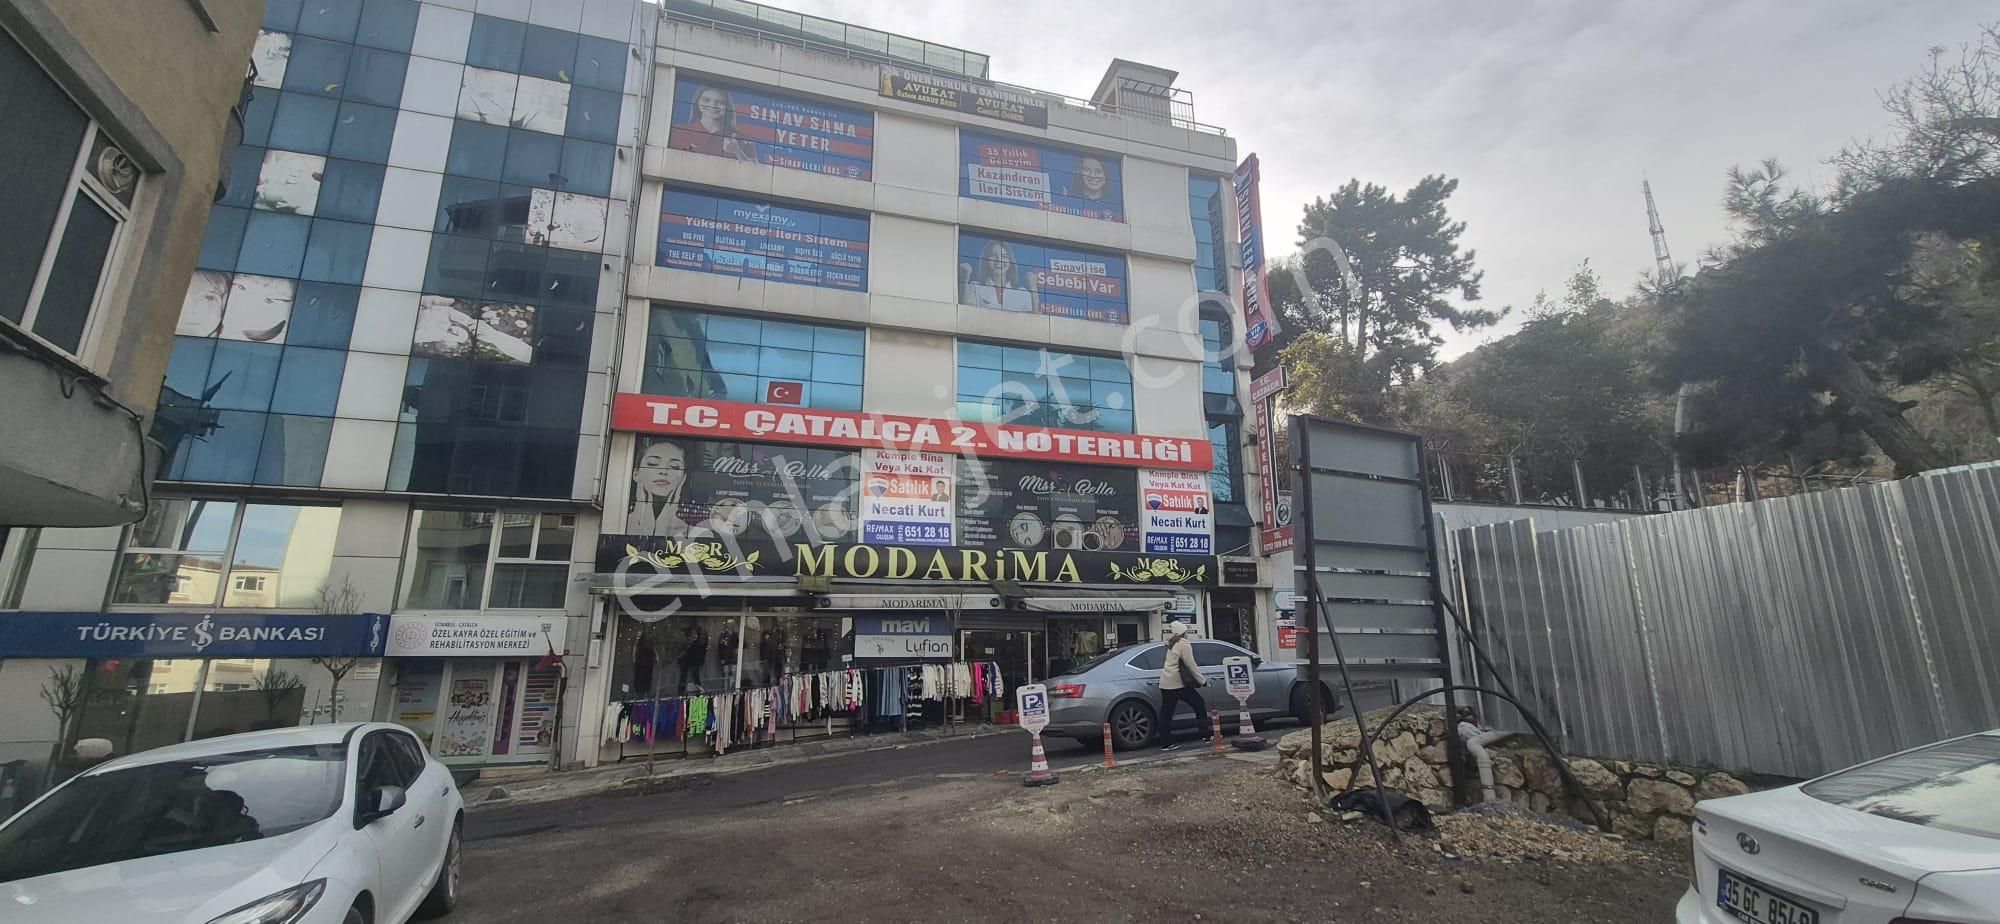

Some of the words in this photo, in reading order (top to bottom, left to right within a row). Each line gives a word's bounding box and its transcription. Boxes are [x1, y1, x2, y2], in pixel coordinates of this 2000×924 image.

[904, 82, 955, 100] AVUKAT
[976, 97, 1024, 113] AVUKAT
[750, 105, 803, 126] SINAV
[810, 116, 857, 137] SANA
[776, 128, 830, 152] YETER
[977, 167, 1041, 185] Kazandıran
[1005, 186, 1045, 201] Sistem
[685, 216, 731, 232] Yüksek
[806, 234, 848, 248] Sistem
[1089, 264, 1105, 274] ise
[1037, 272, 1087, 291] Sebebi
[1088, 278, 1115, 294] Var
[1245, 274, 1260, 315] KURS
[1250, 326, 1261, 338] VIP
[646, 401, 731, 429] T.C.
[743, 409, 941, 446] ÇATALCA
[951, 426, 987, 448] 2.
[998, 429, 1193, 463] NOTERLİĞİ
[876, 450, 917, 462] Komple
[920, 453, 944, 463] Bina
[874, 462, 901, 472] Veya
[904, 464, 923, 473] Kat
[926, 465, 945, 474] Kat
[1149, 470, 1179, 480] Komple
[1180, 472, 1199, 480] Bina
[890, 478, 929, 495] Satılık
[1019, 475, 1057, 494] Miss
[1074, 479, 1117, 496] Bella
[1149, 480, 1169, 489] Veya
[1171, 481, 1185, 489] Kat
[1187, 482, 1201, 490] Kat
[1162, 494, 1193, 509] Satılık
[872, 503, 914, 517] Necati
[918, 504, 946, 518] Kurt
[866, 524, 894, 534] RE/MAX
[1151, 515, 1182, 528] Necati
[1185, 517, 1206, 528] Kurt
[904, 525, 921, 538] 651
[924, 526, 936, 538] 28
[938, 527, 950, 538] 18
[1147, 535, 1168, 545] RE/MAX
[1175, 536, 1188, 548] 651
[1189, 537, 1198, 549] 28
[1199, 538, 1209, 549] 18
[76, 622, 188, 641] TÜRKİYE
[218, 626, 326, 641] BANKASI
[881, 616, 930, 633] mavi
[431, 629, 451, 638] ÖZEL
[452, 630, 478, 638] KAYRA
[480, 628, 499, 638] ÖZEL
[500, 628, 527, 639] EĞİTİM
[429, 639, 496, 649] REHABİLİTASYON
[497, 639, 530, 649] MERKEZİ
[1231, 665, 1243, 678] P
[1025, 694, 1039, 709] P
[1726, 879, 1740, 906] 35
[1743, 886, 1760, 917] GC
